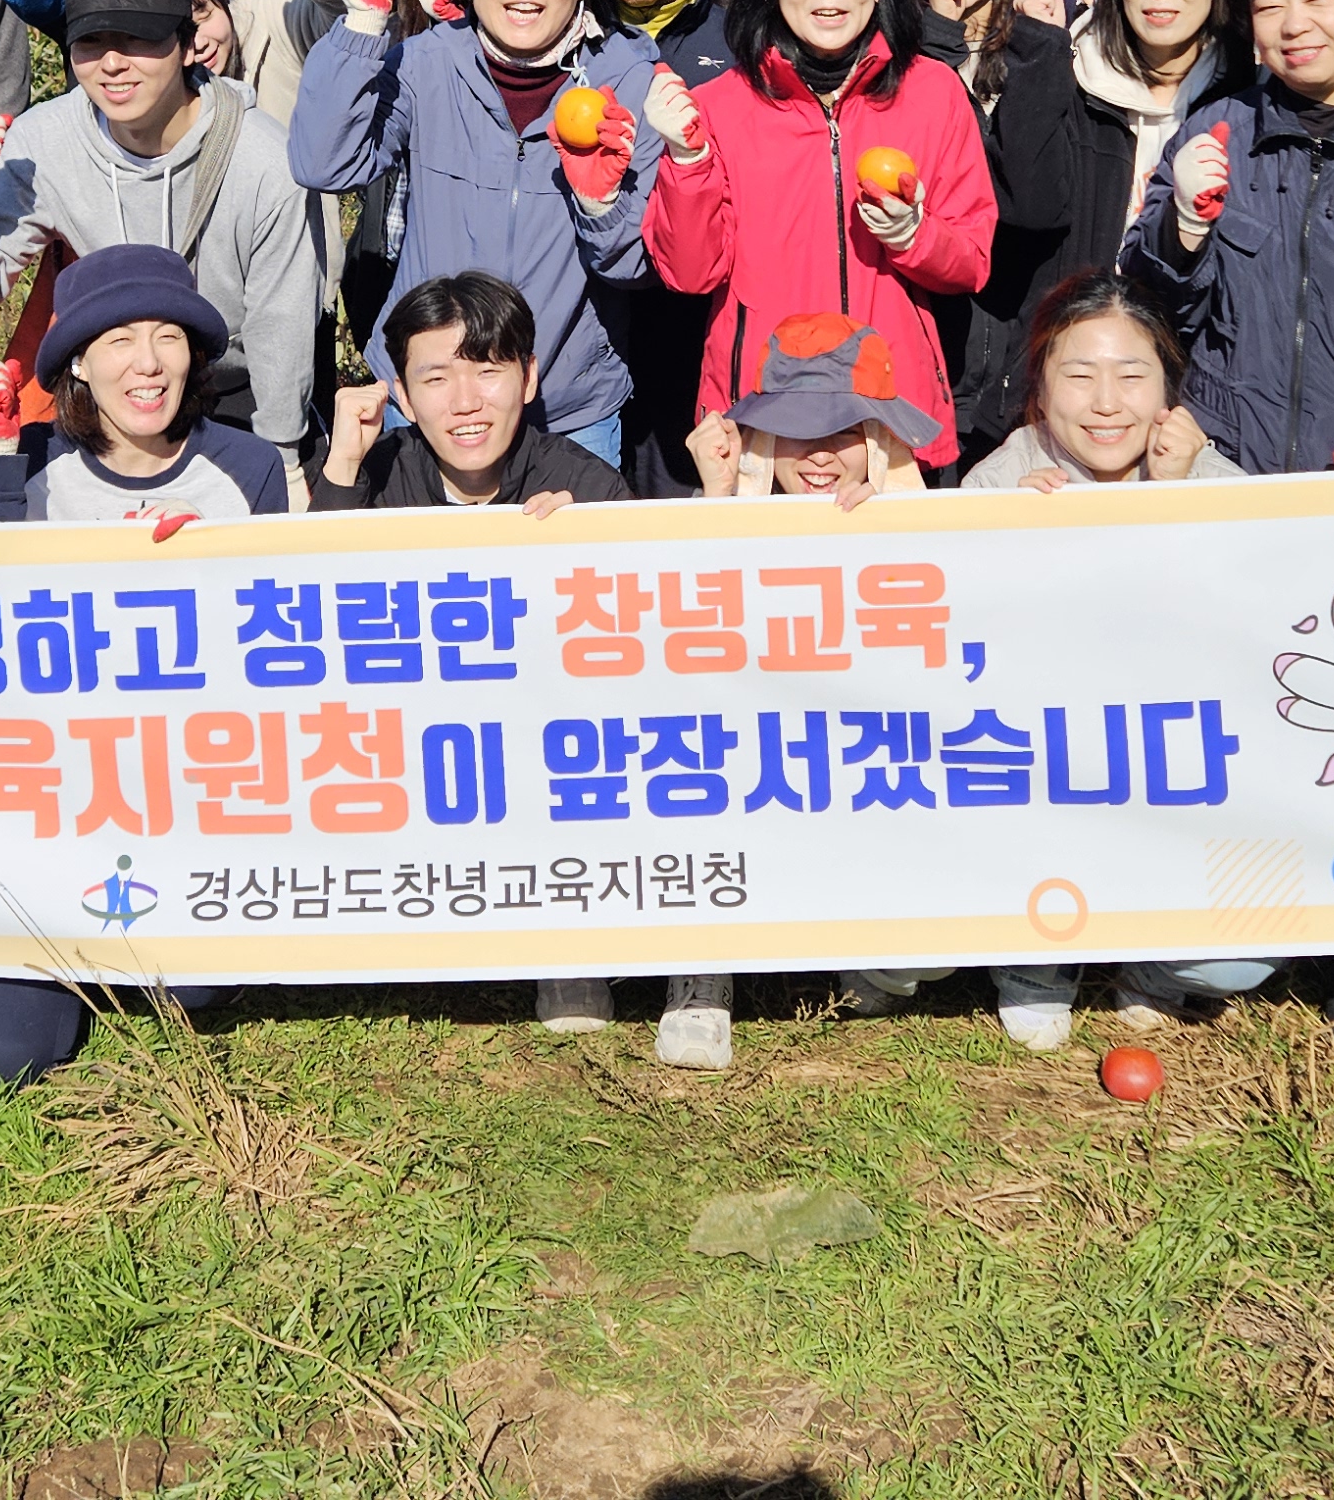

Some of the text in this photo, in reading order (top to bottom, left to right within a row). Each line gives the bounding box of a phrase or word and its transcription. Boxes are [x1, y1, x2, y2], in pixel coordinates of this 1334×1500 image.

[235, 572, 528, 688] 청렴한
[555, 563, 986, 682] 창녕교육,
[542, 699, 1240, 822] 앞장서겠습니다
[185, 850, 748, 922] 경상남도창녕교육지원청
